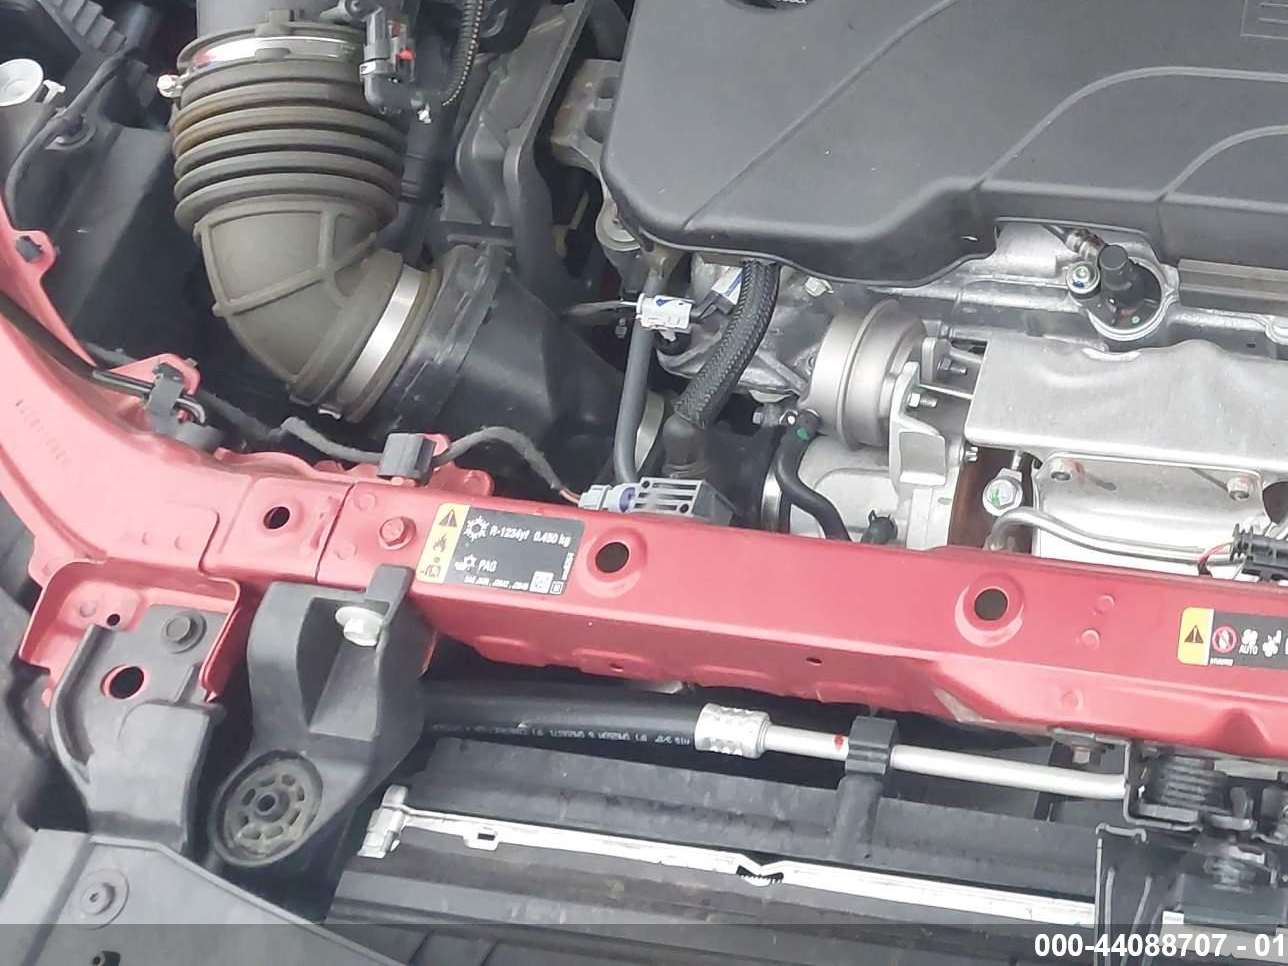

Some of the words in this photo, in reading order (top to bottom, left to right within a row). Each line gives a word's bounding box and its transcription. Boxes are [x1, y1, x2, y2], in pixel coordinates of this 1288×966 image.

[489, 525, 530, 542] R-1234yf
[559, 532, 572, 548] kg
[478, 559, 498, 573] PAG
[1239, 645, 1259, 655] AUTO
